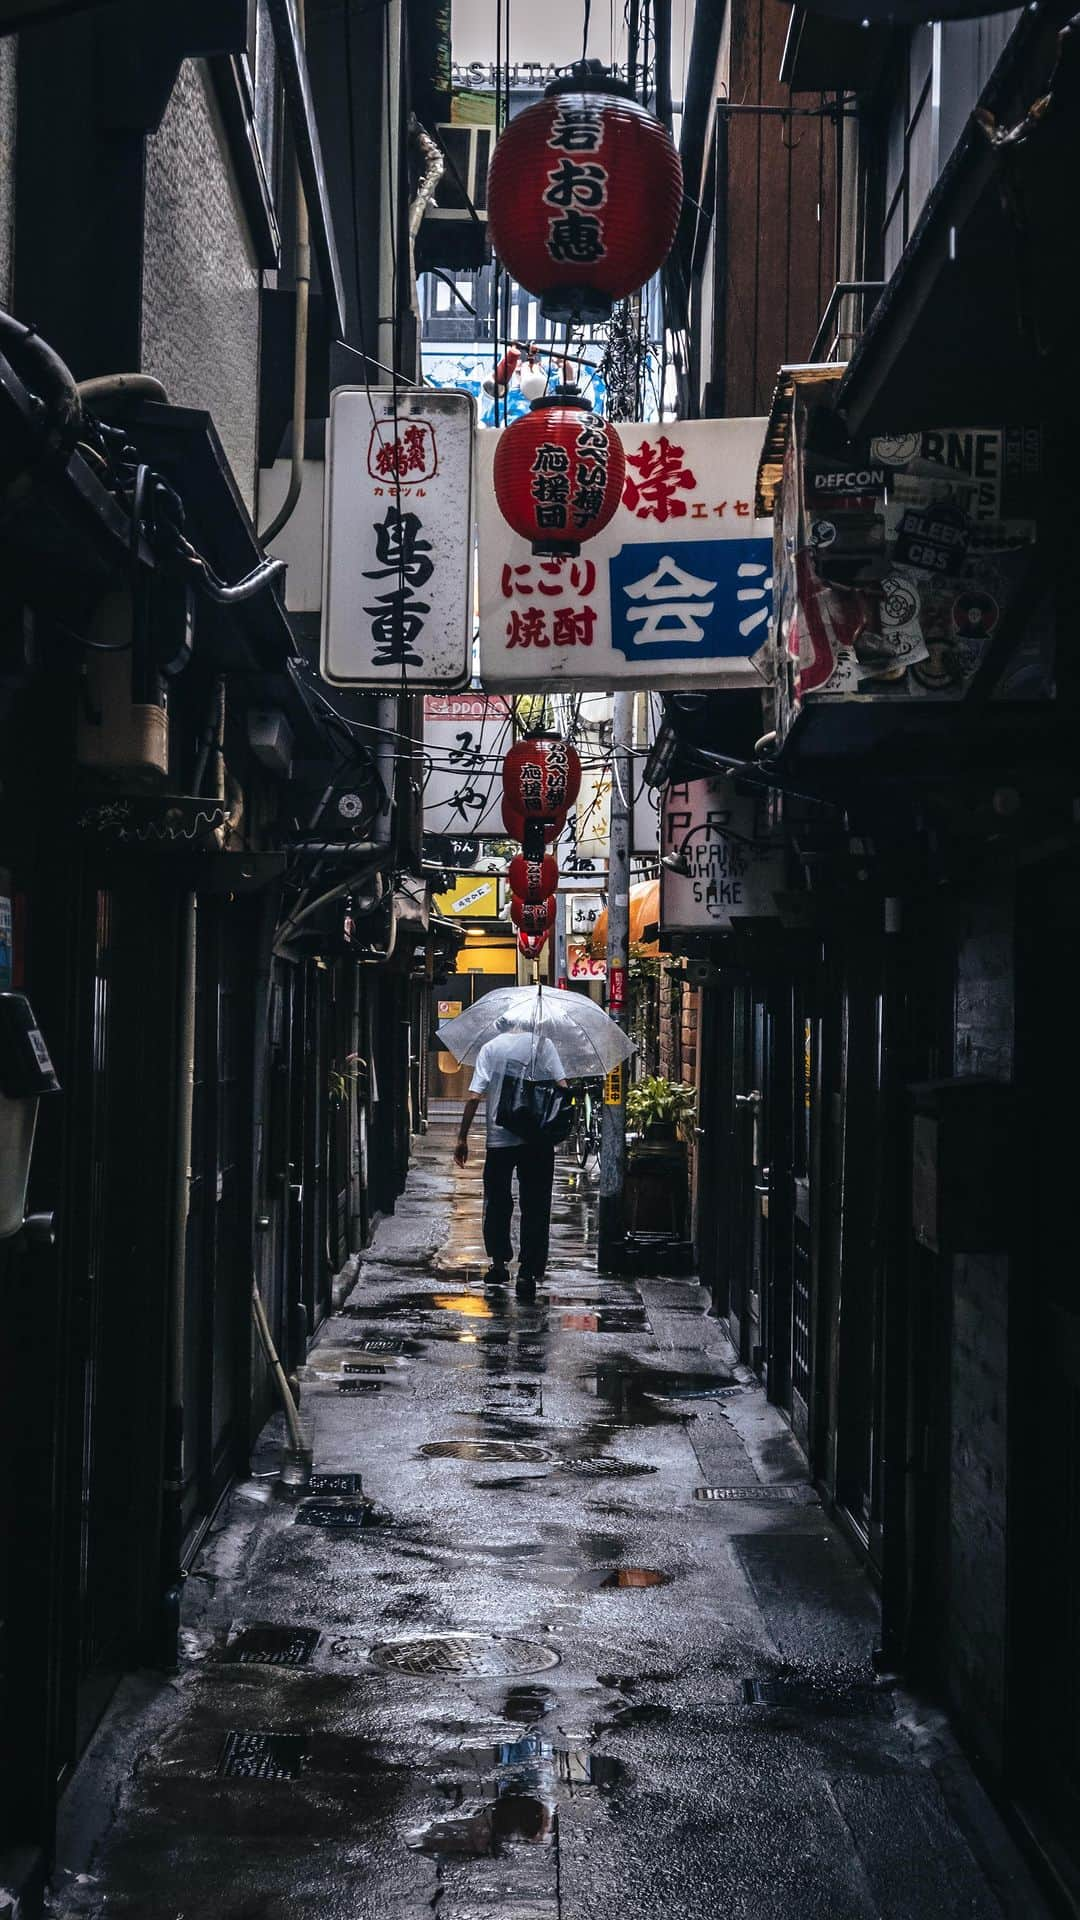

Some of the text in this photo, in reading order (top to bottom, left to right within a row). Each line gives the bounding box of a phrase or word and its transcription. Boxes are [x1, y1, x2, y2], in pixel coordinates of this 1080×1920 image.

[373, 487, 427, 497] カモツル
[530, 443, 570, 528] 応援団
[814, 470, 885, 489] DEFCON
[361, 505, 436, 668] 鳥重
[502, 558, 597, 599] にごり
[506, 605, 598, 649] 焼酎
[447, 731, 488, 823] みや
[692, 879, 743, 904] SAKE
